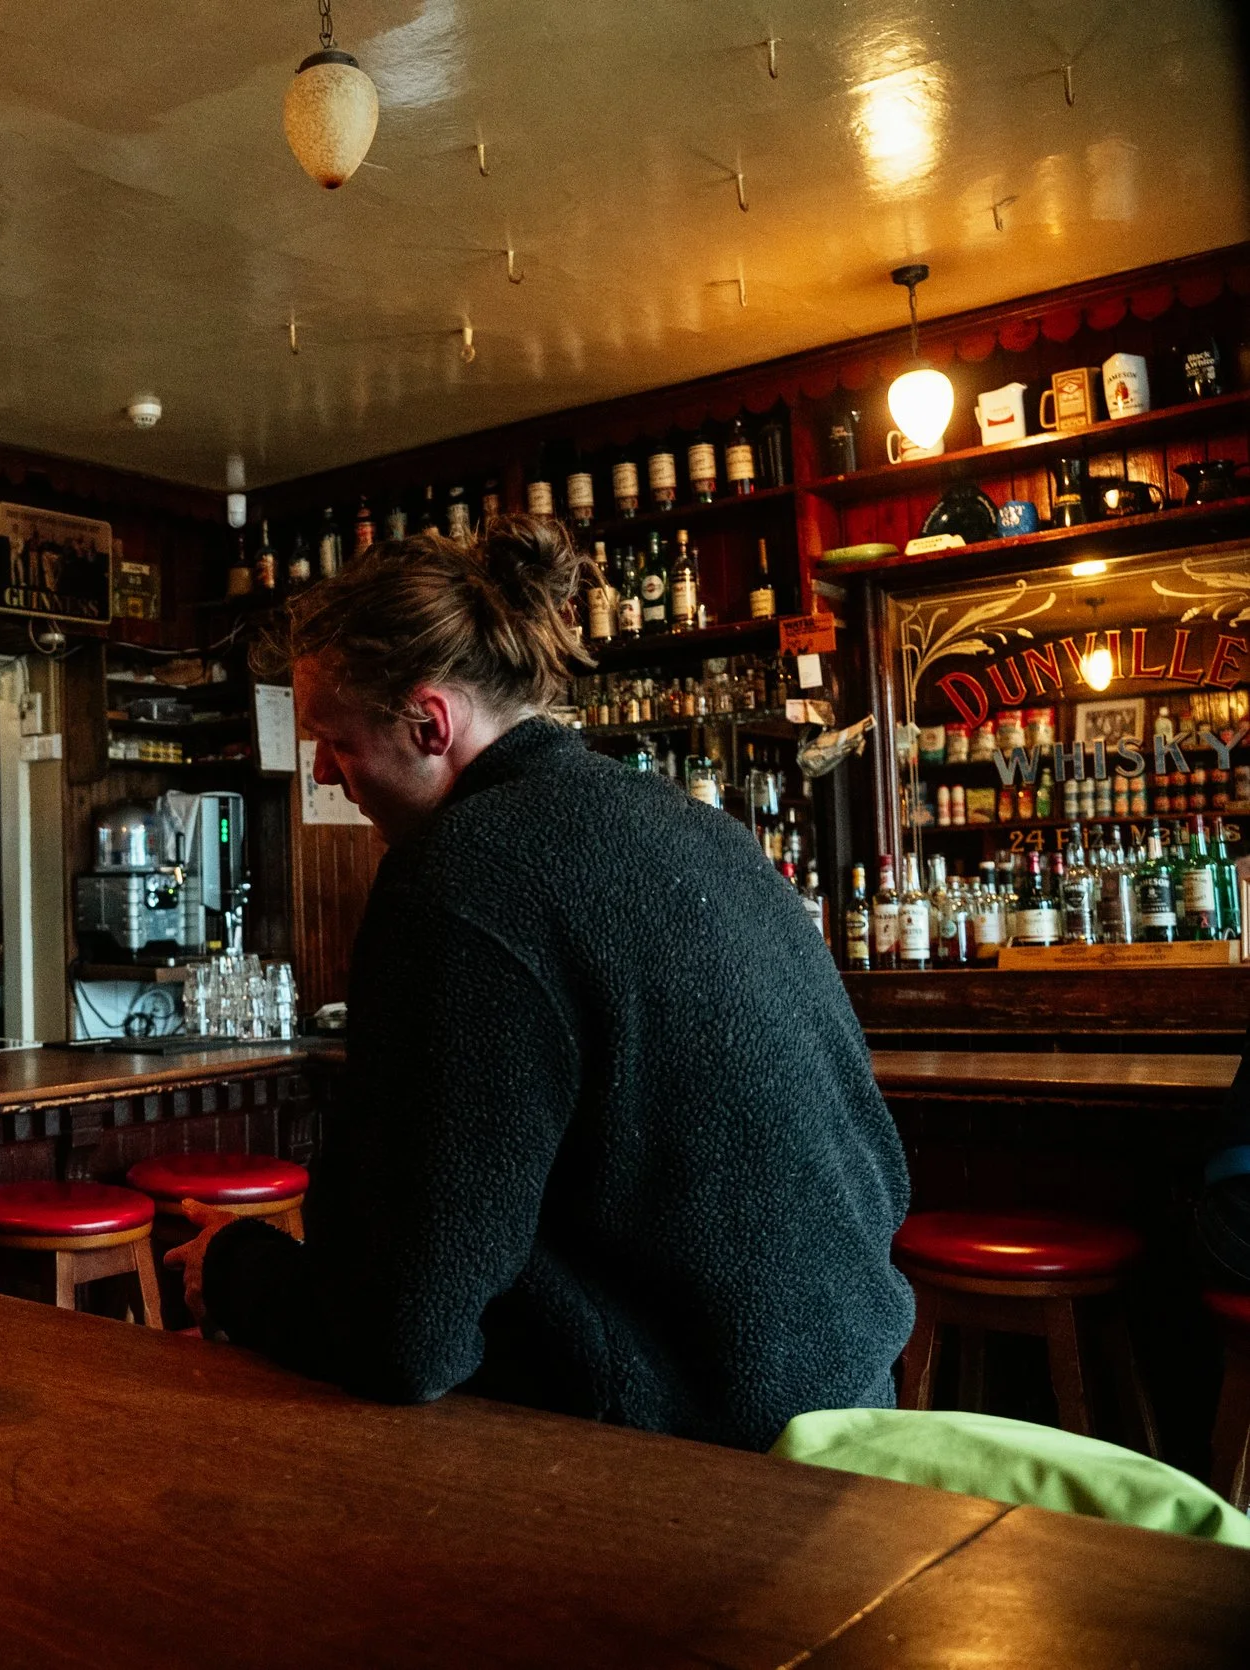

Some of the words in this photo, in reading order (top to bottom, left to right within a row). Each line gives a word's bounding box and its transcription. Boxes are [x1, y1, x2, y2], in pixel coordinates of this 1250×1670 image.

[1107, 371, 1137, 385] JAMESON
[3, 586, 100, 618] GUINNESS
[935, 627, 1249, 730] DUNVILLE
[993, 727, 1250, 786] WHISKY
[1008, 829, 1045, 853] 24
